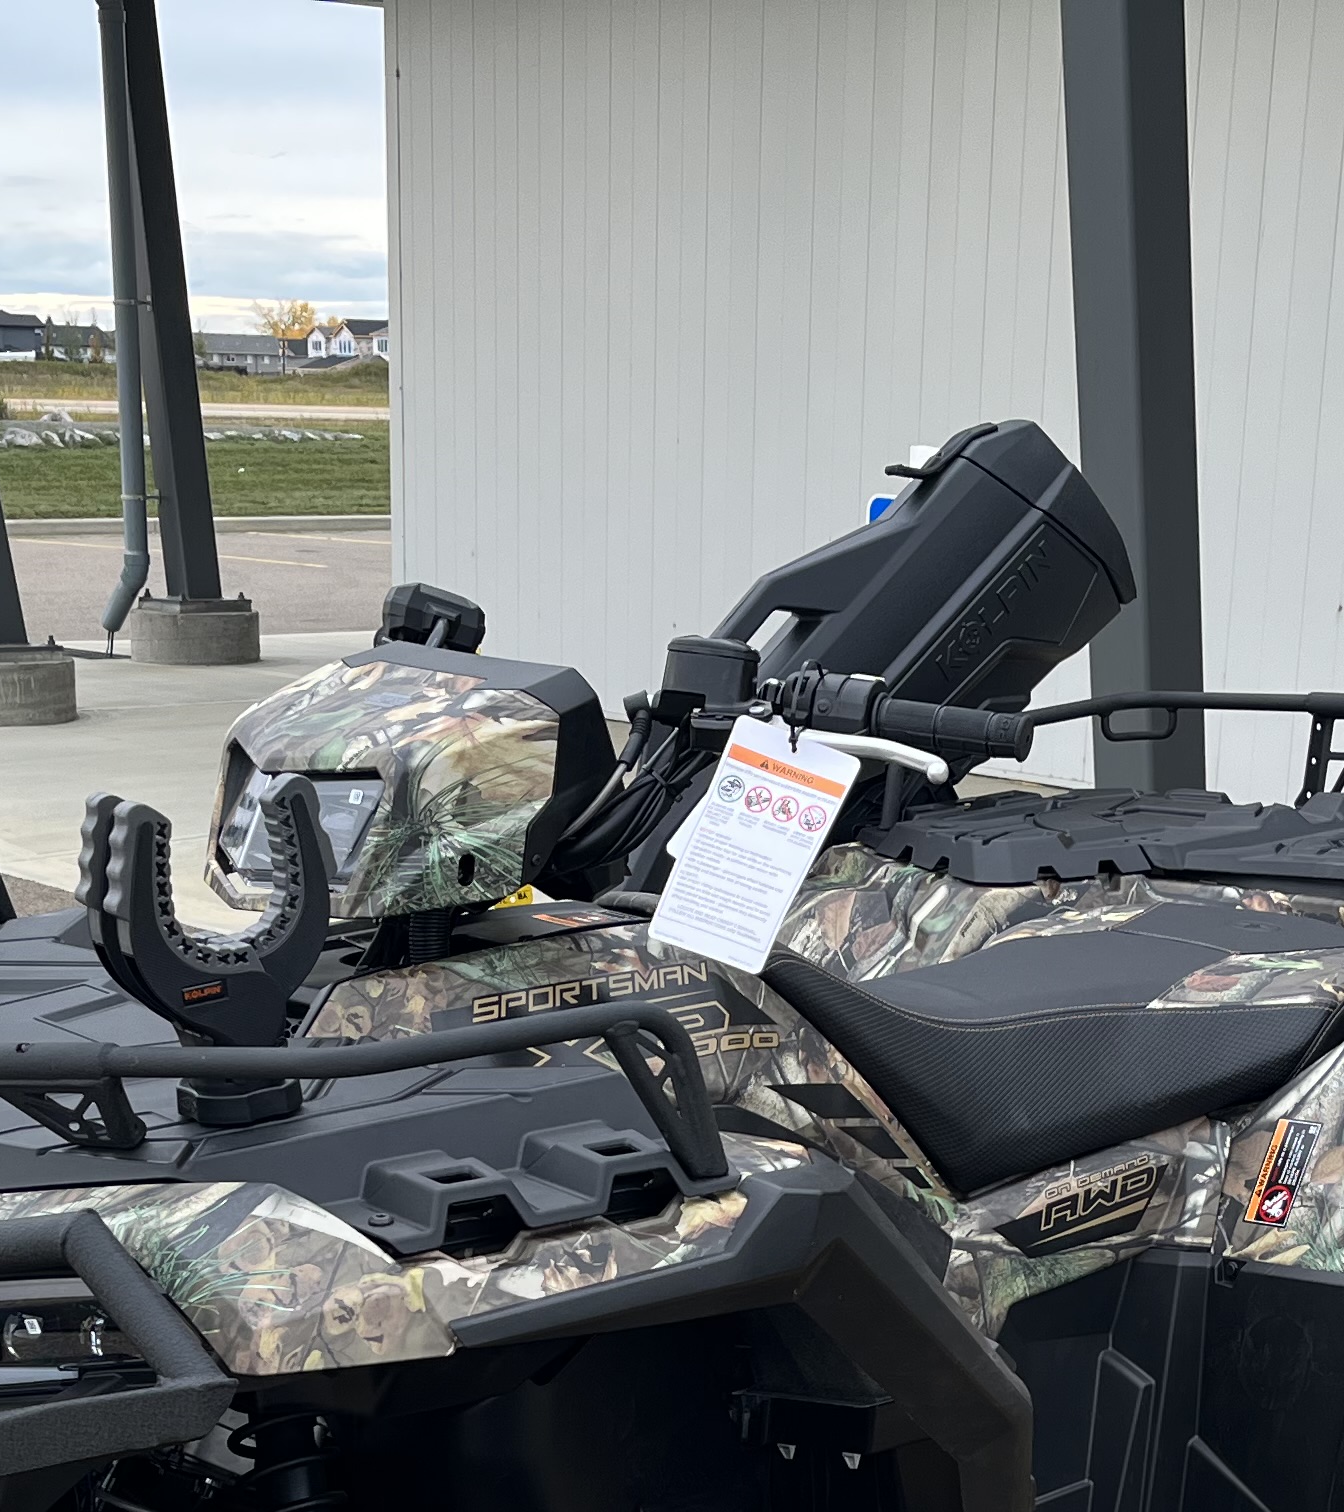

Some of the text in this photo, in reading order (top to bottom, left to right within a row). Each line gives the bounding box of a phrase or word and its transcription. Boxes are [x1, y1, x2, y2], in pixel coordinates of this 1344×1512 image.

[935, 539, 1051, 682] KOLPIN
[771, 762, 815, 785] WARNING
[472, 961, 710, 1024] SPORTSMAN
[1076, 1154, 1150, 1188] DEMAND
[1259, 1144, 1278, 1188] WARNING
[1040, 1165, 1157, 1232] AWD
